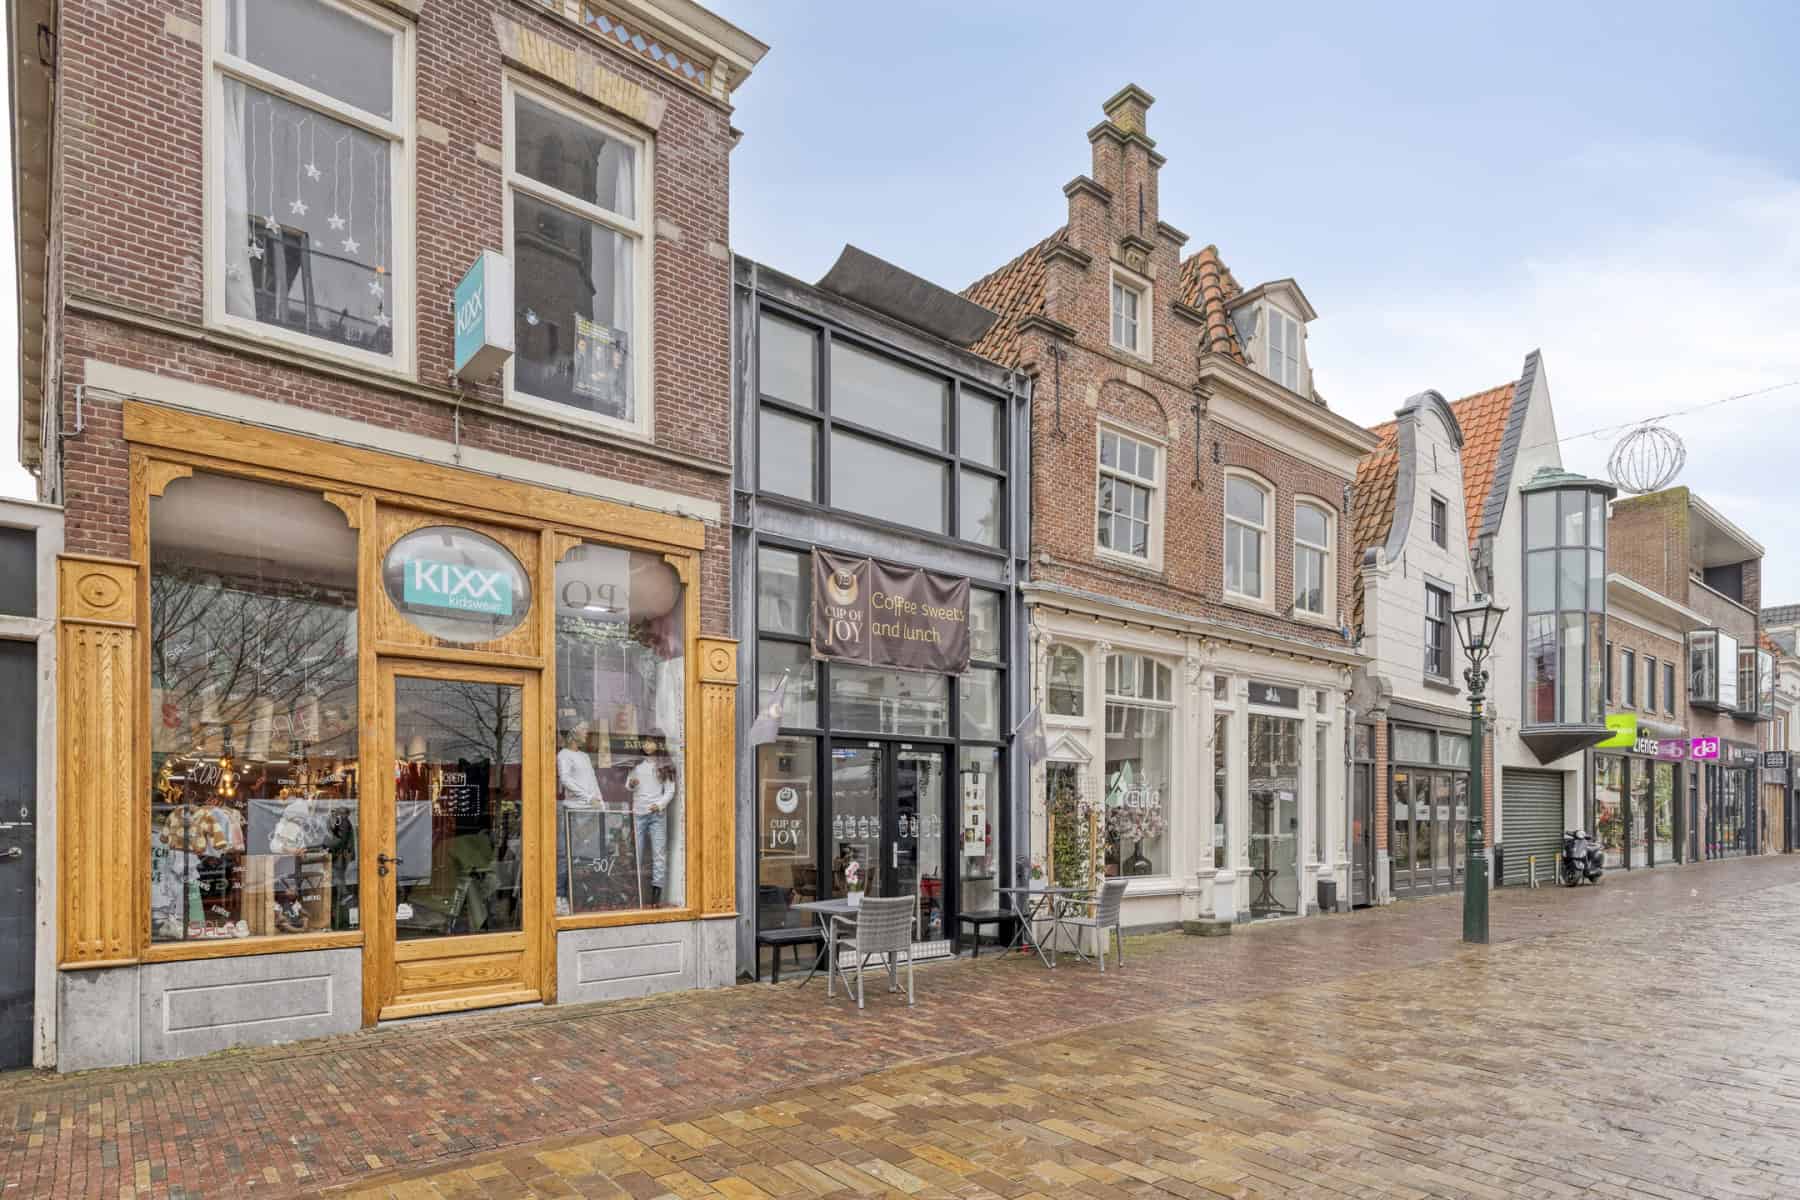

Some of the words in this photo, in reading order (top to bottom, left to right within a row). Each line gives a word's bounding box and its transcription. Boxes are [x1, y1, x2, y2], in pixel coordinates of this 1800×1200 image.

[457, 281, 483, 336] KIXX
[415, 561, 502, 601] KIXX
[825, 606, 847, 619] CUP
[849, 609, 865, 620] OF
[871, 591, 917, 617] Coffee
[921, 604, 965, 622] sweets
[825, 619, 864, 646] JOY
[872, 621, 900, 638] and
[903, 624, 942, 643] lunch
[1694, 740, 1717, 757] da
[770, 819, 789, 829] CUP
[790, 819, 802, 829] OF
[770, 829, 802, 849] JOY
